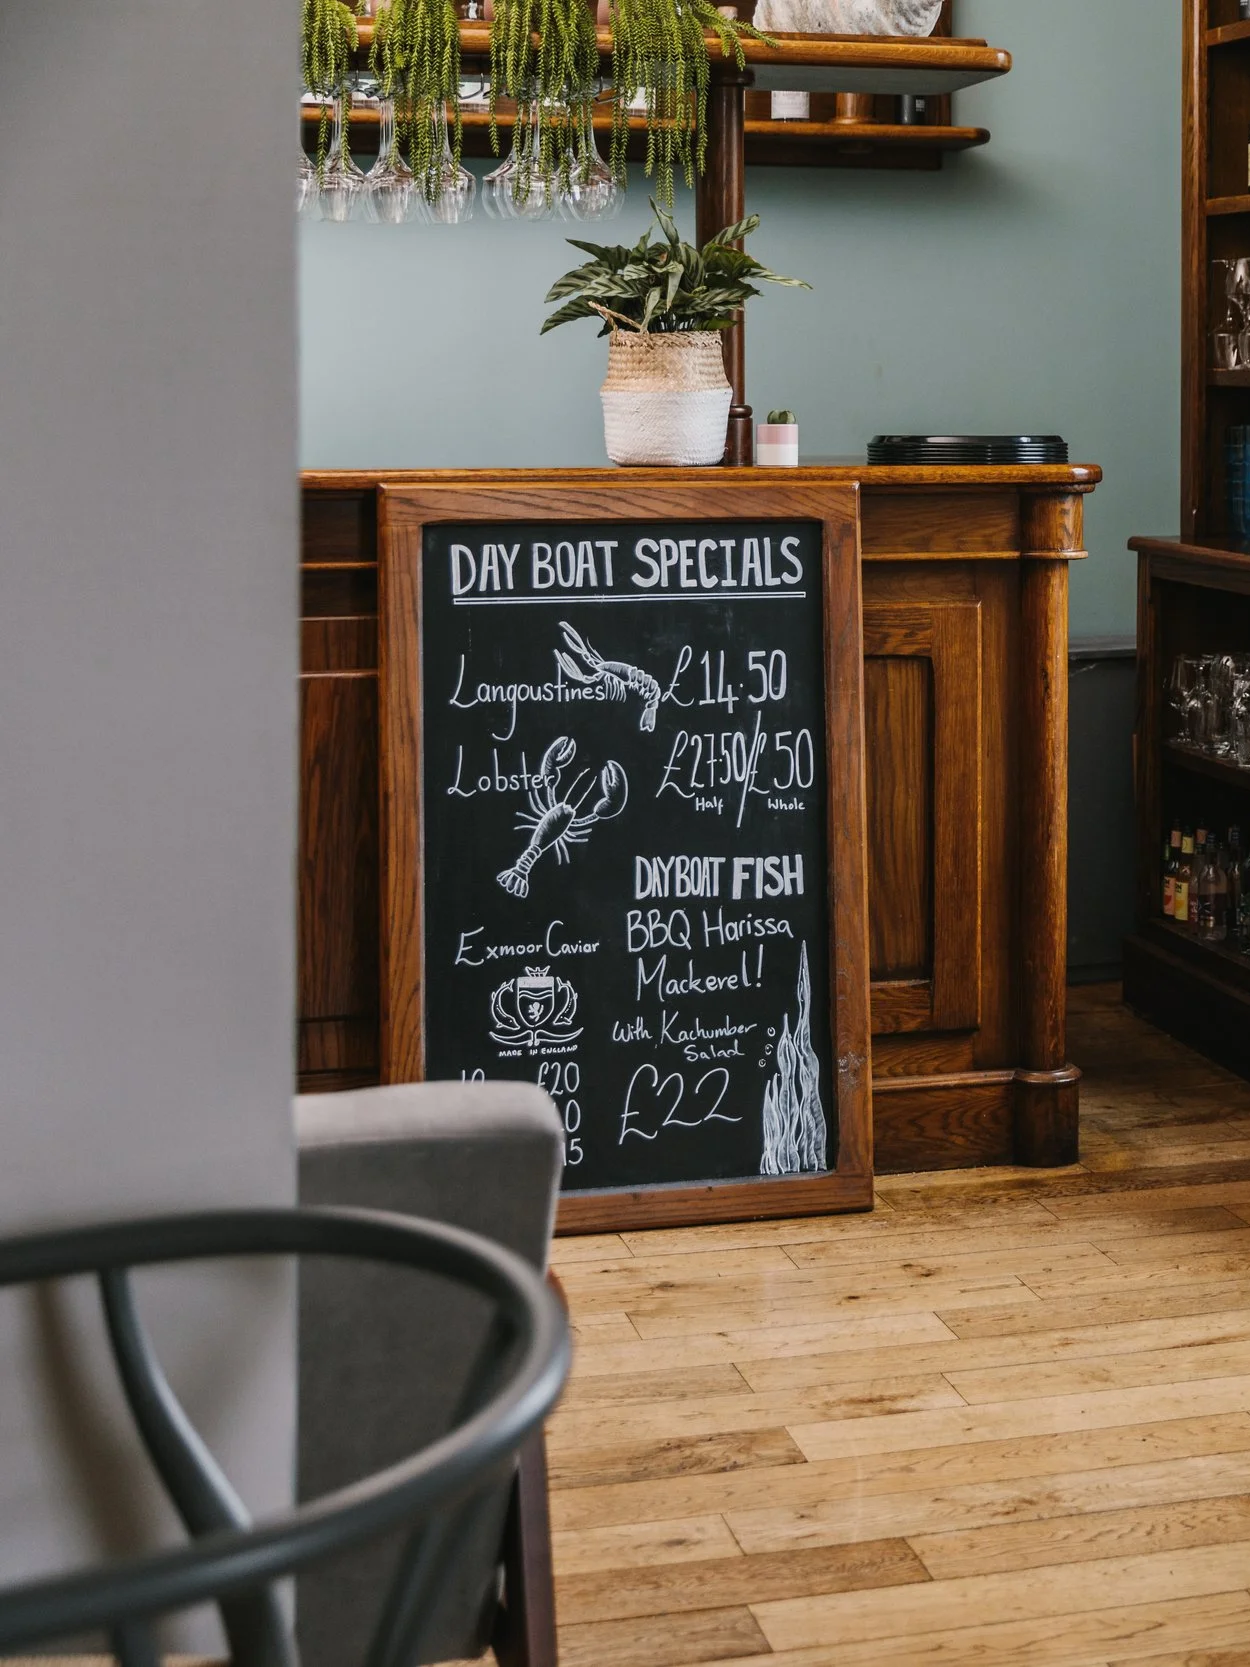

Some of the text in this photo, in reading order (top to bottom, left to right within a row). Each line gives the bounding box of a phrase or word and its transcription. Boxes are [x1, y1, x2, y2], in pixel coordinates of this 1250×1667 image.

[451, 536, 803, 596] DAY BOAT SPECIALS
[450, 645, 787, 741] Langoustines £14.50
[448, 745, 555, 797] Lobster
[696, 796, 805, 815] Half Whole
[732, 854, 804, 900] FISH
[455, 920, 600, 965] Exmoor Caviar
[627, 905, 794, 952] BBQ Harissa
[636, 943, 764, 1002] Mackerel!
[541, 1044, 578, 1055] ENGLAND
[660, 1009, 757, 1044] Kachumber
[683, 1039, 745, 1062] Salad
[618, 1063, 743, 1145] £22
